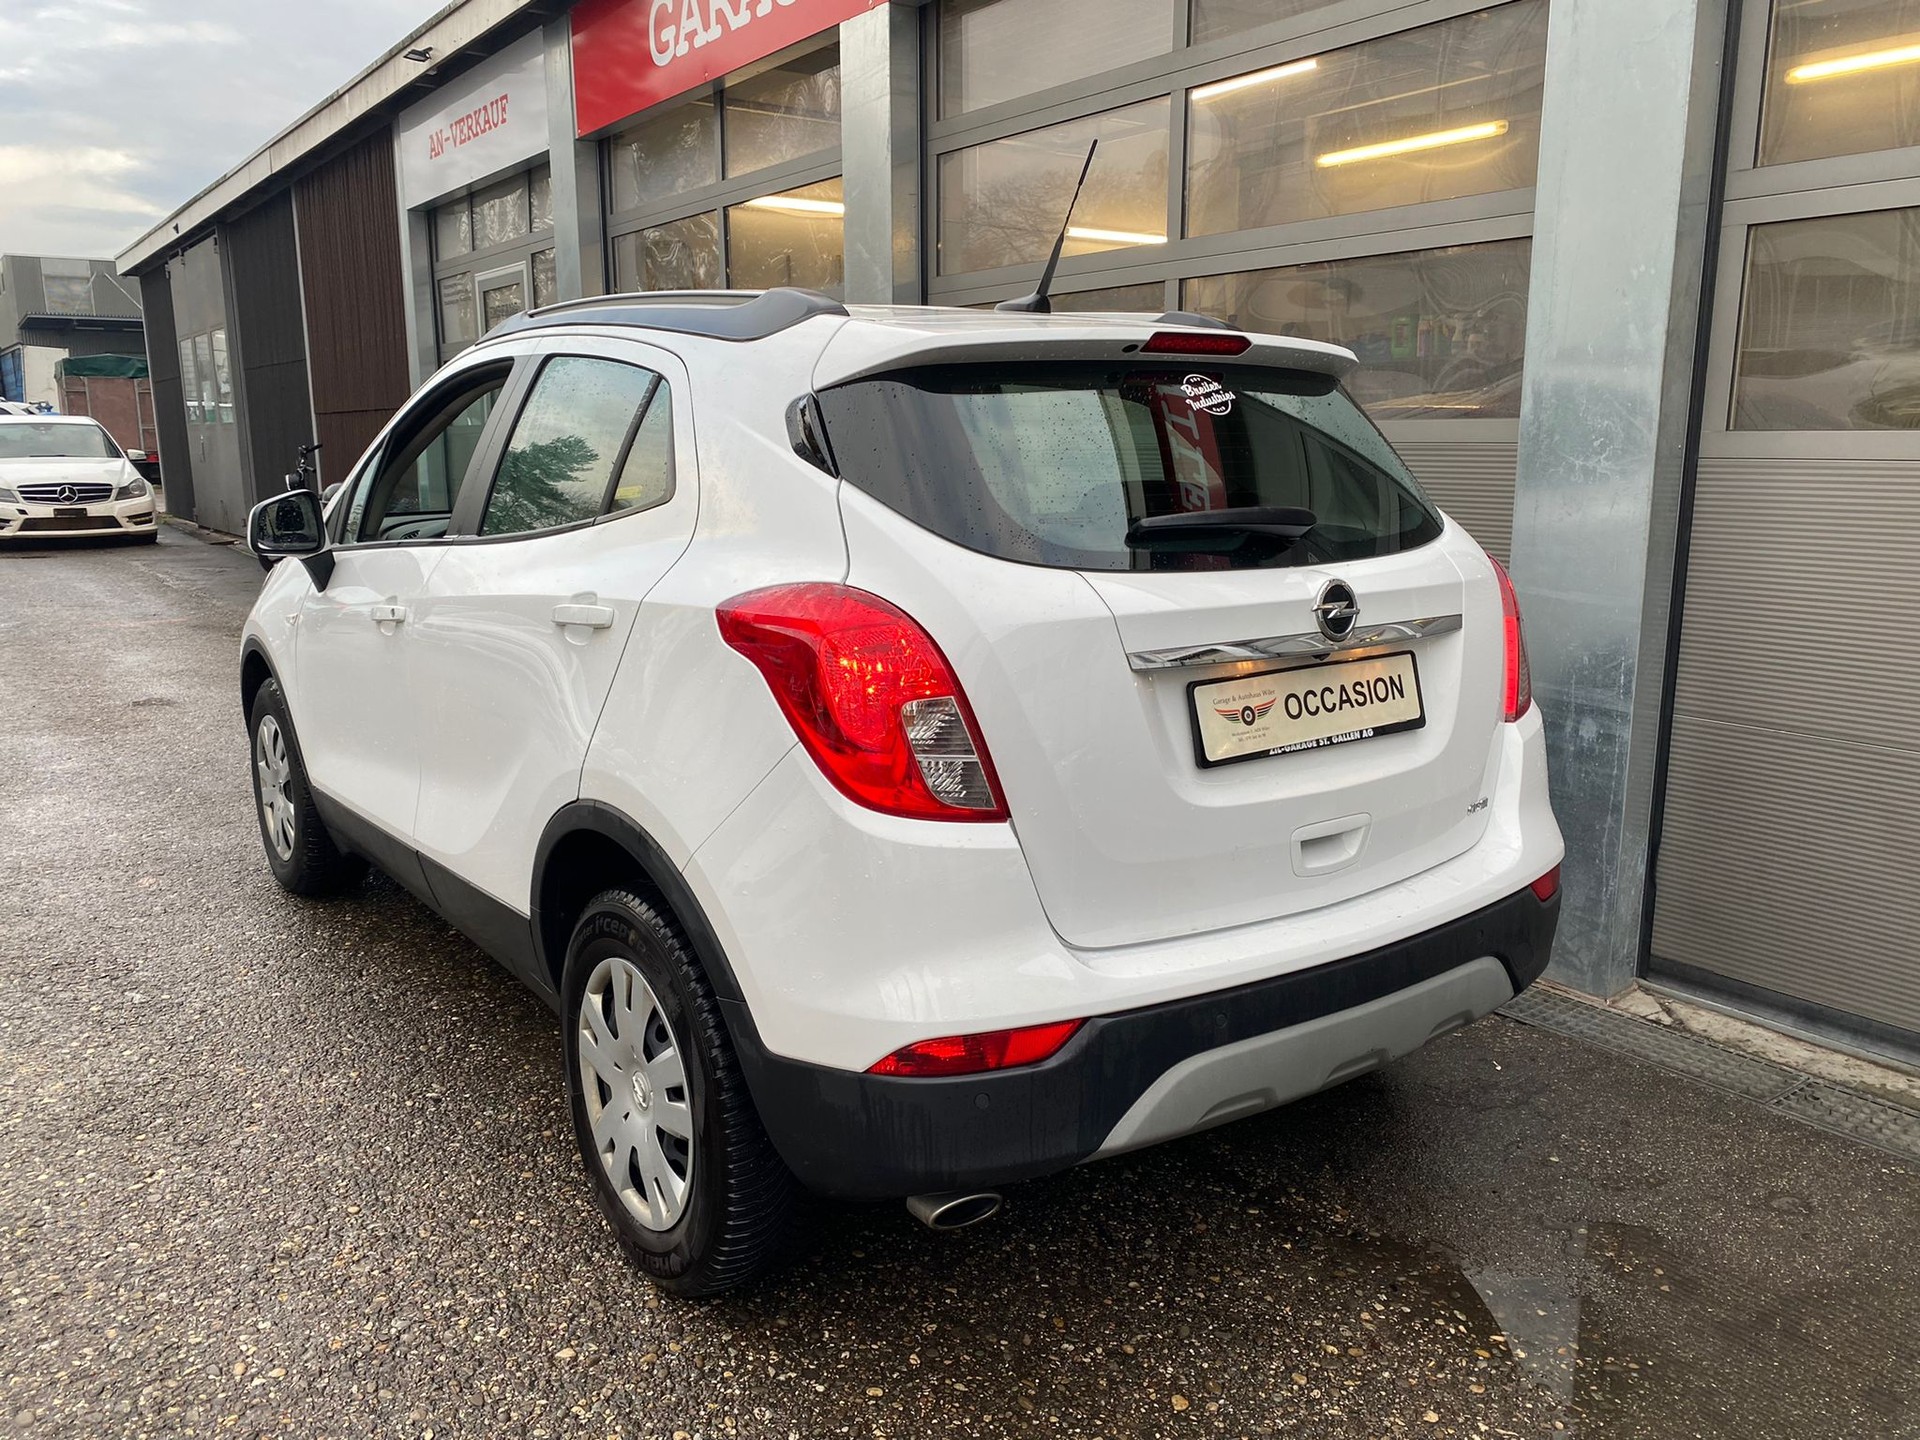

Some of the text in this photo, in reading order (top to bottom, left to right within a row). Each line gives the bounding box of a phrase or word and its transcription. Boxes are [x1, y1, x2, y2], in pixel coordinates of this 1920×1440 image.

[428, 93, 509, 160] AN-VERKAUF
[1213, 697, 1230, 705] Garage
[1238, 691, 1261, 701] Autohaus
[1284, 674, 1405, 720] OCCASION
[1331, 731, 1361, 744] GALLEN
[1362, 728, 1374, 738] AG
